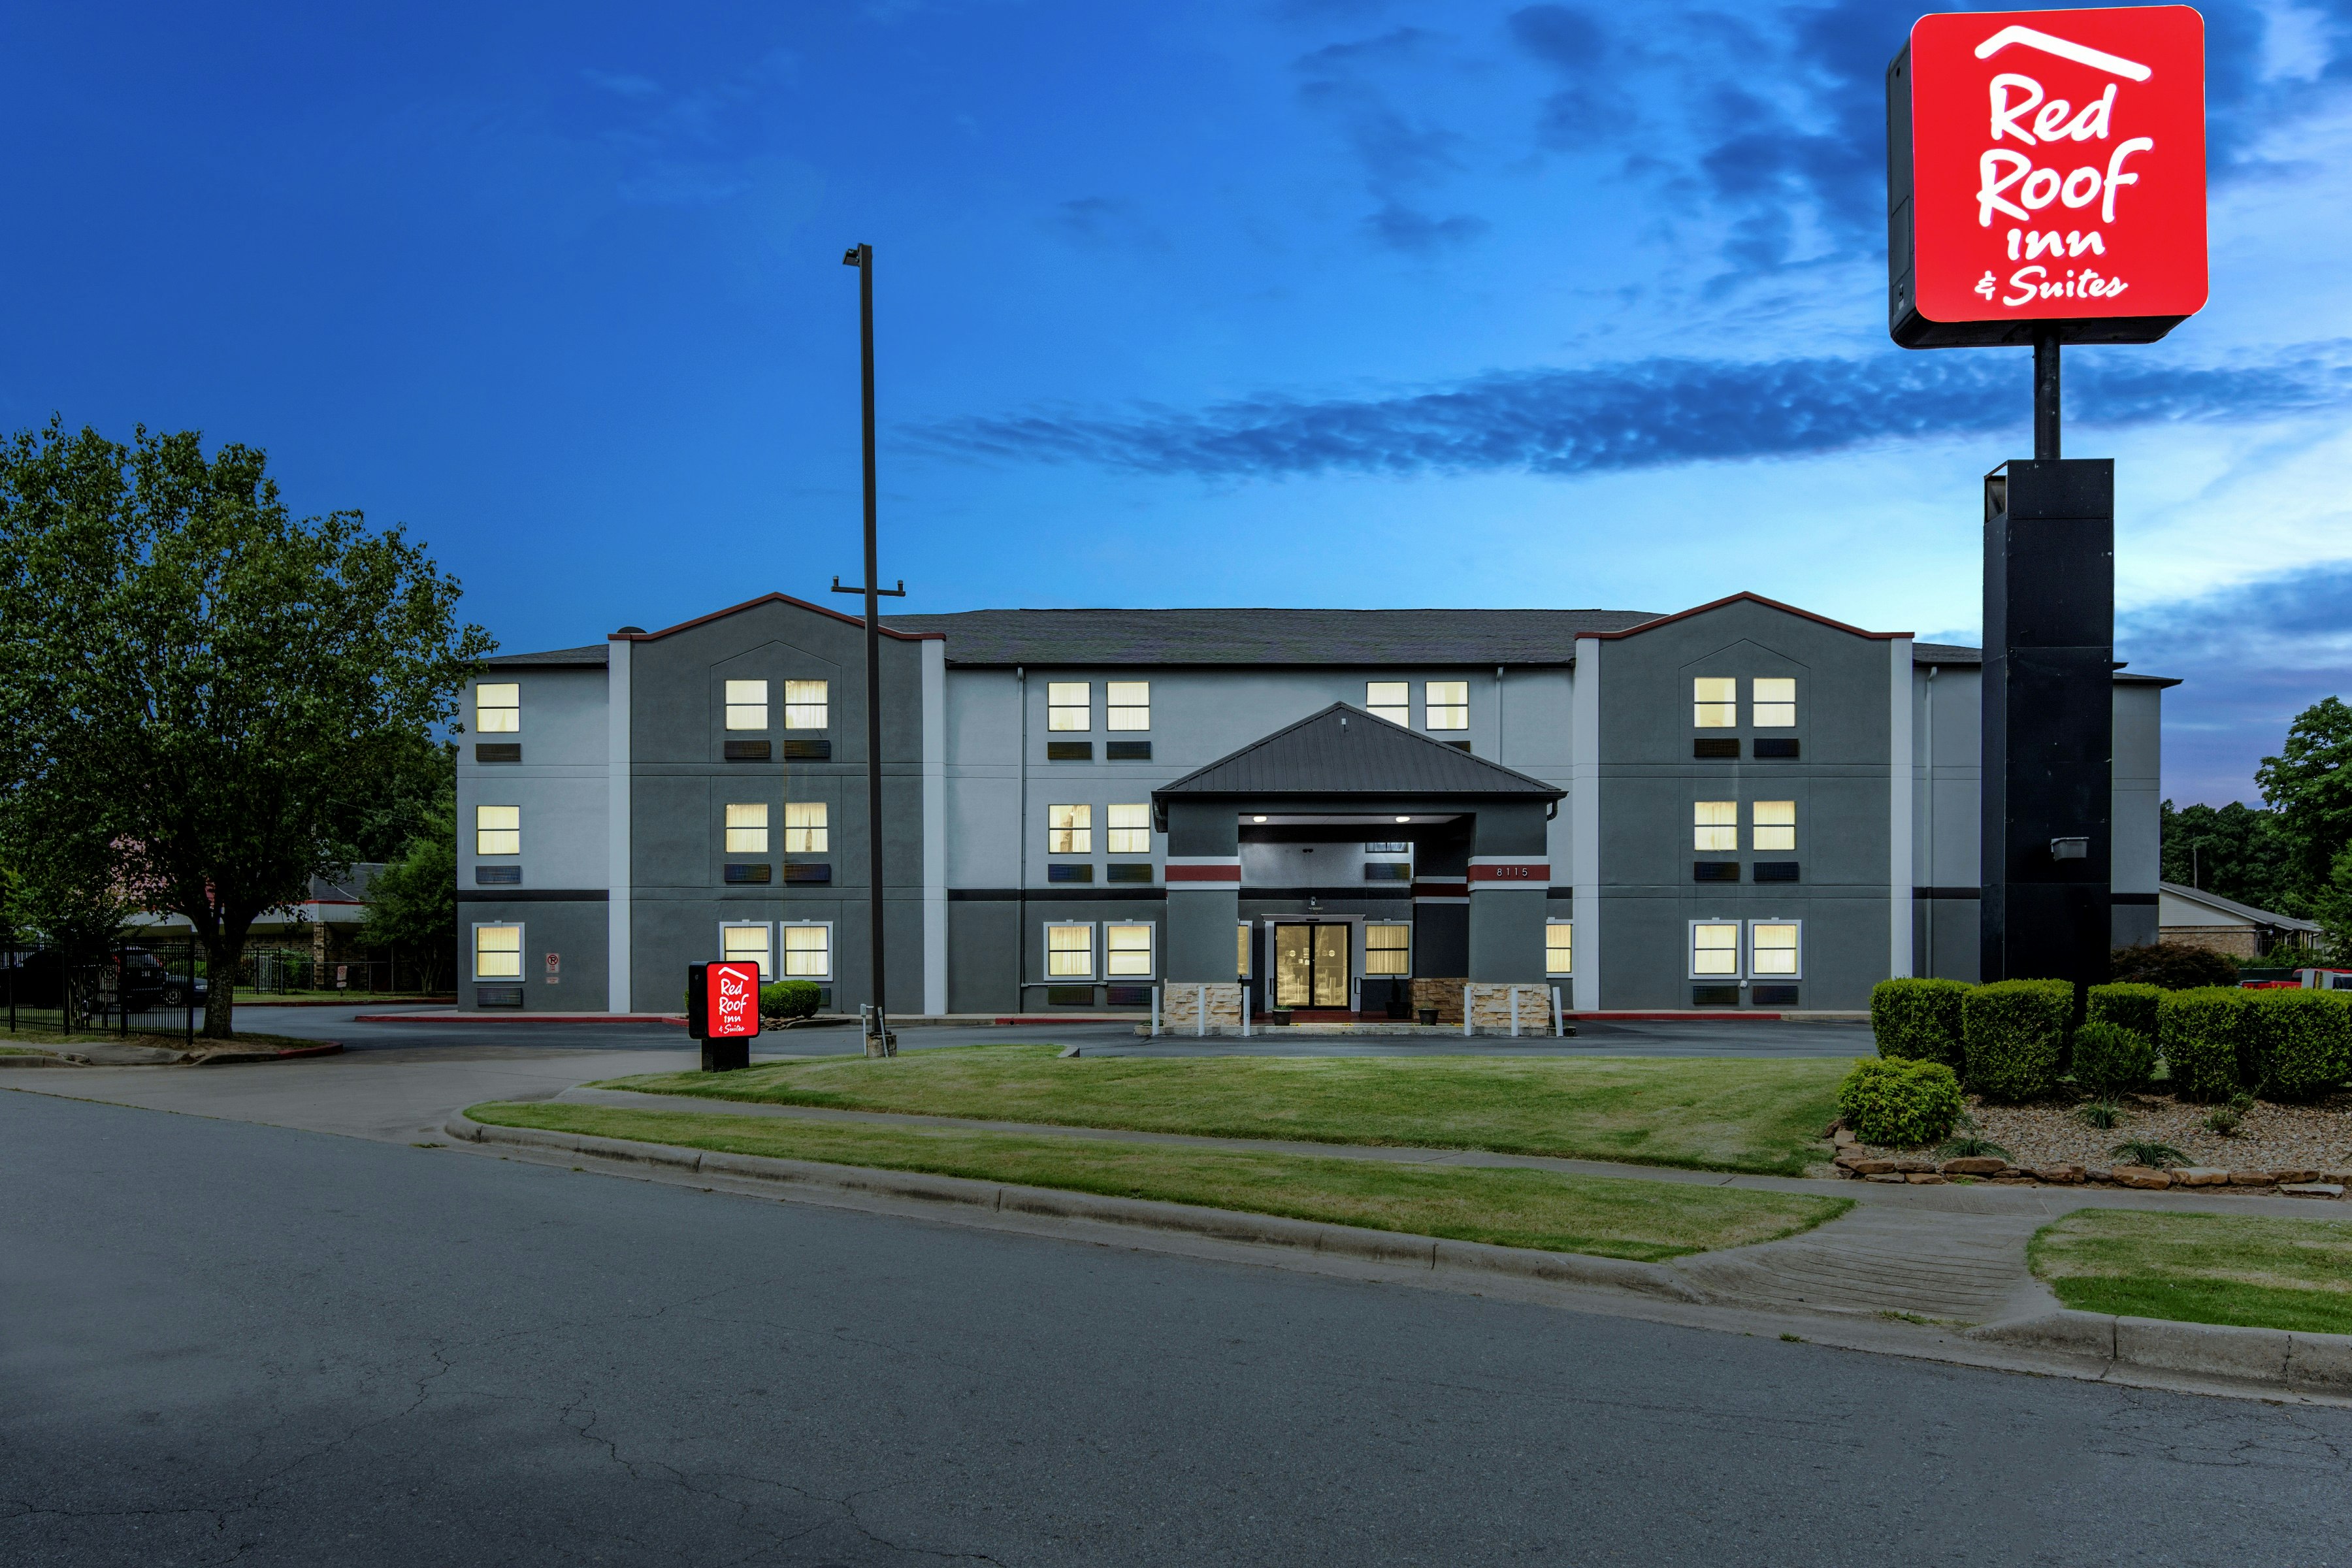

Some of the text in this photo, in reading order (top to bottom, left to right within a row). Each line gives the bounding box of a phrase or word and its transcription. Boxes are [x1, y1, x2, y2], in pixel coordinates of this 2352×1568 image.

[1989, 73, 2117, 146] Red
[1976, 137, 2153, 227] Roof
[1974, 265, 2129, 306] & Suites
[1497, 868, 1527, 876] 8115
[721, 978, 743, 996] Red
[719, 994, 749, 1015] Roof
[723, 1024, 745, 1034] Suites
